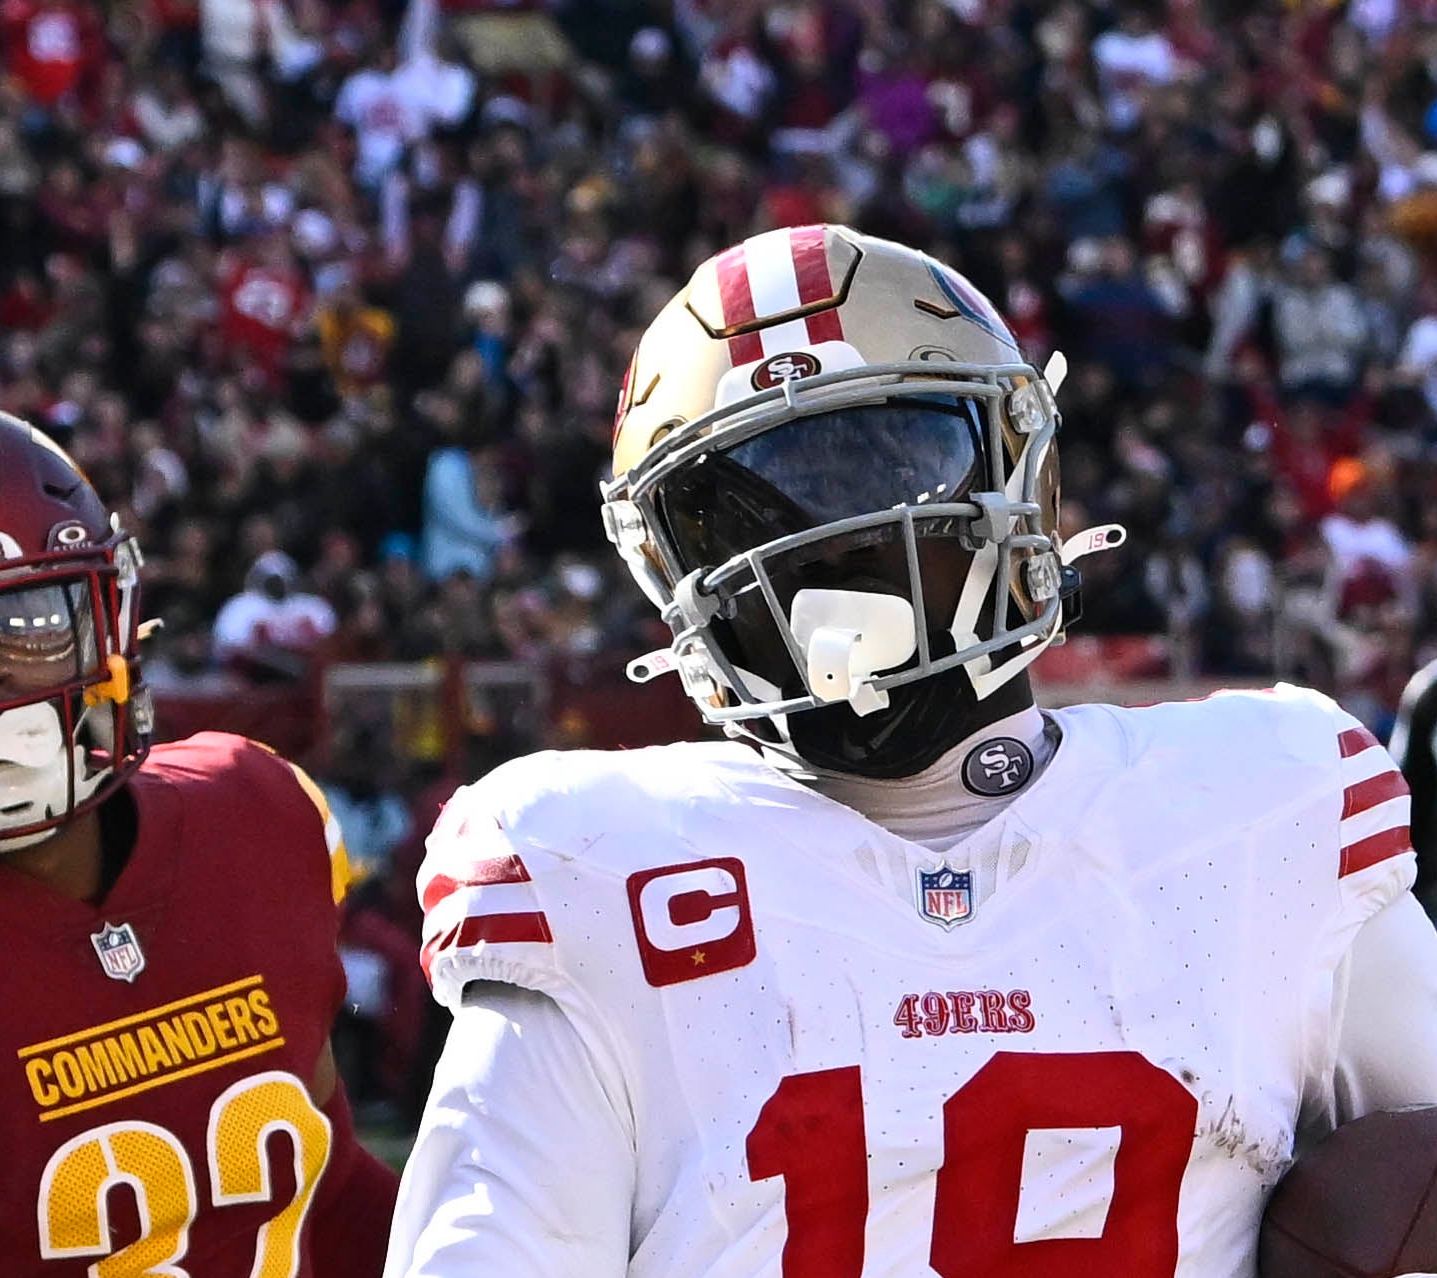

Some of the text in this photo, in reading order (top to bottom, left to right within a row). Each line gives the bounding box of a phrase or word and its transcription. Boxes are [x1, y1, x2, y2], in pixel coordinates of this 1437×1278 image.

[1089, 533, 1105, 549] 19
[639, 866, 741, 952] C
[927, 889, 968, 918] NFL
[107, 946, 139, 972] NFL
[893, 989, 1036, 1039] 49ERS
[25, 989, 279, 1107] COMMANDERS
